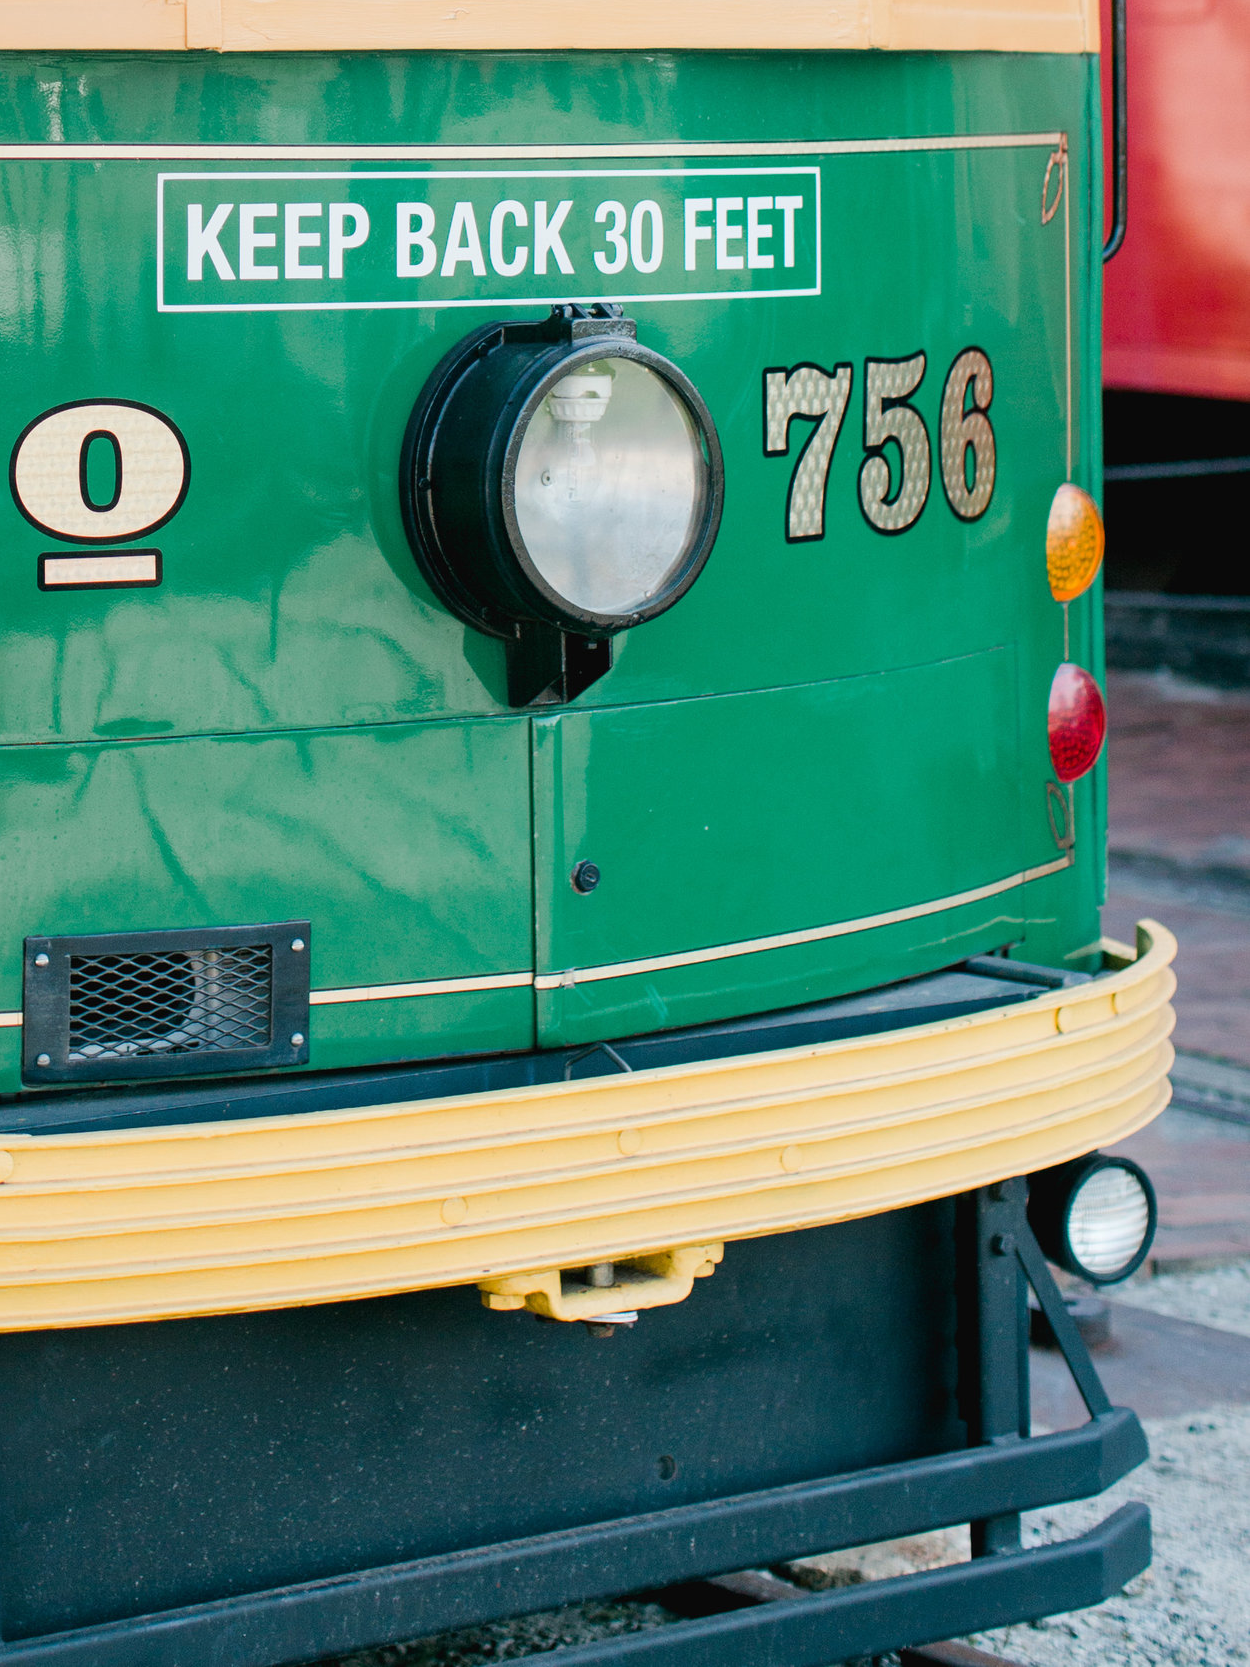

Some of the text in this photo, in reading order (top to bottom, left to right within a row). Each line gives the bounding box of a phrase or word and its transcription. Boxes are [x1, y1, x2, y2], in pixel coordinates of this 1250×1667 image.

[186, 195, 805, 282] KEEP BACK 30 FEET
[762, 344, 996, 542] 756
